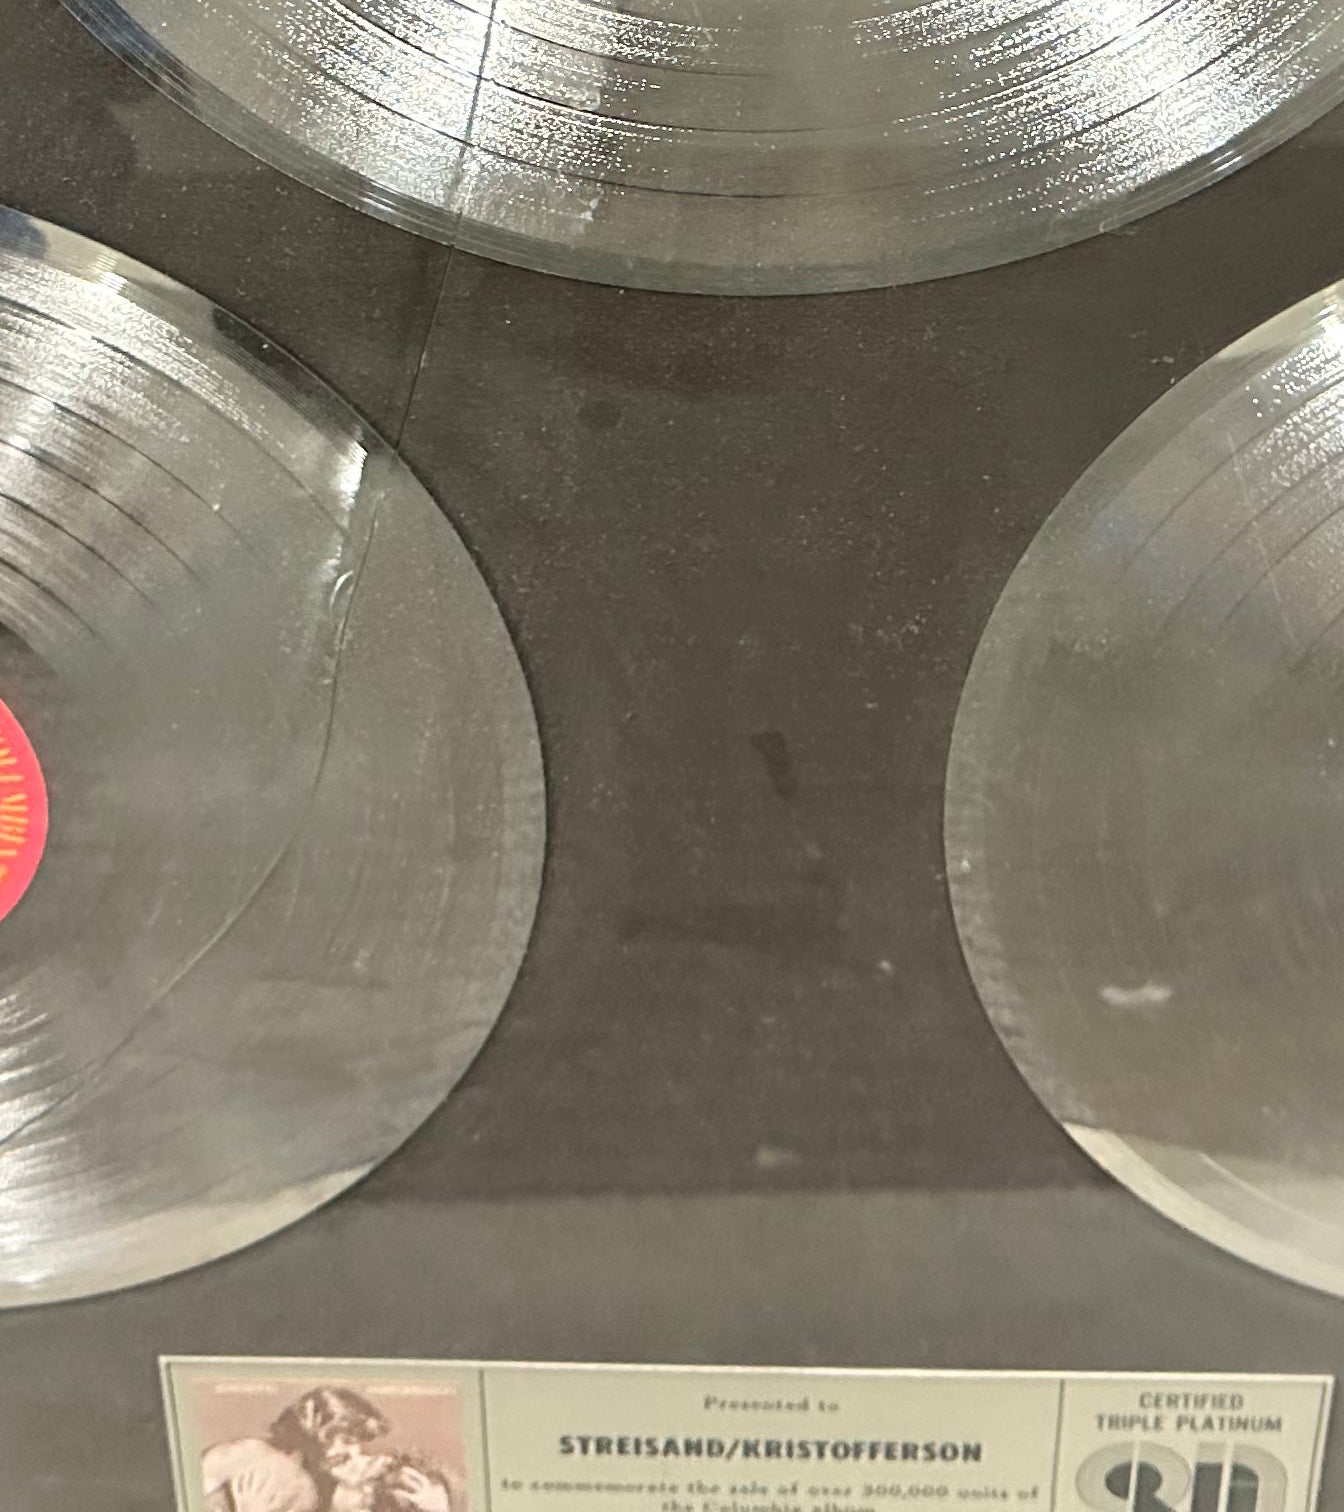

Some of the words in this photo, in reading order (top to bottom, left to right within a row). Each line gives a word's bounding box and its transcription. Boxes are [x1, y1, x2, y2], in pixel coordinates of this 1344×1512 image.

[1138, 1391, 1244, 1411] CERTIFIED
[1096, 1413, 1163, 1432] TRIPLE
[1175, 1414, 1283, 1433] PLATINUM
[559, 1434, 982, 1464] STREISAND/KRISTOFFERSON
